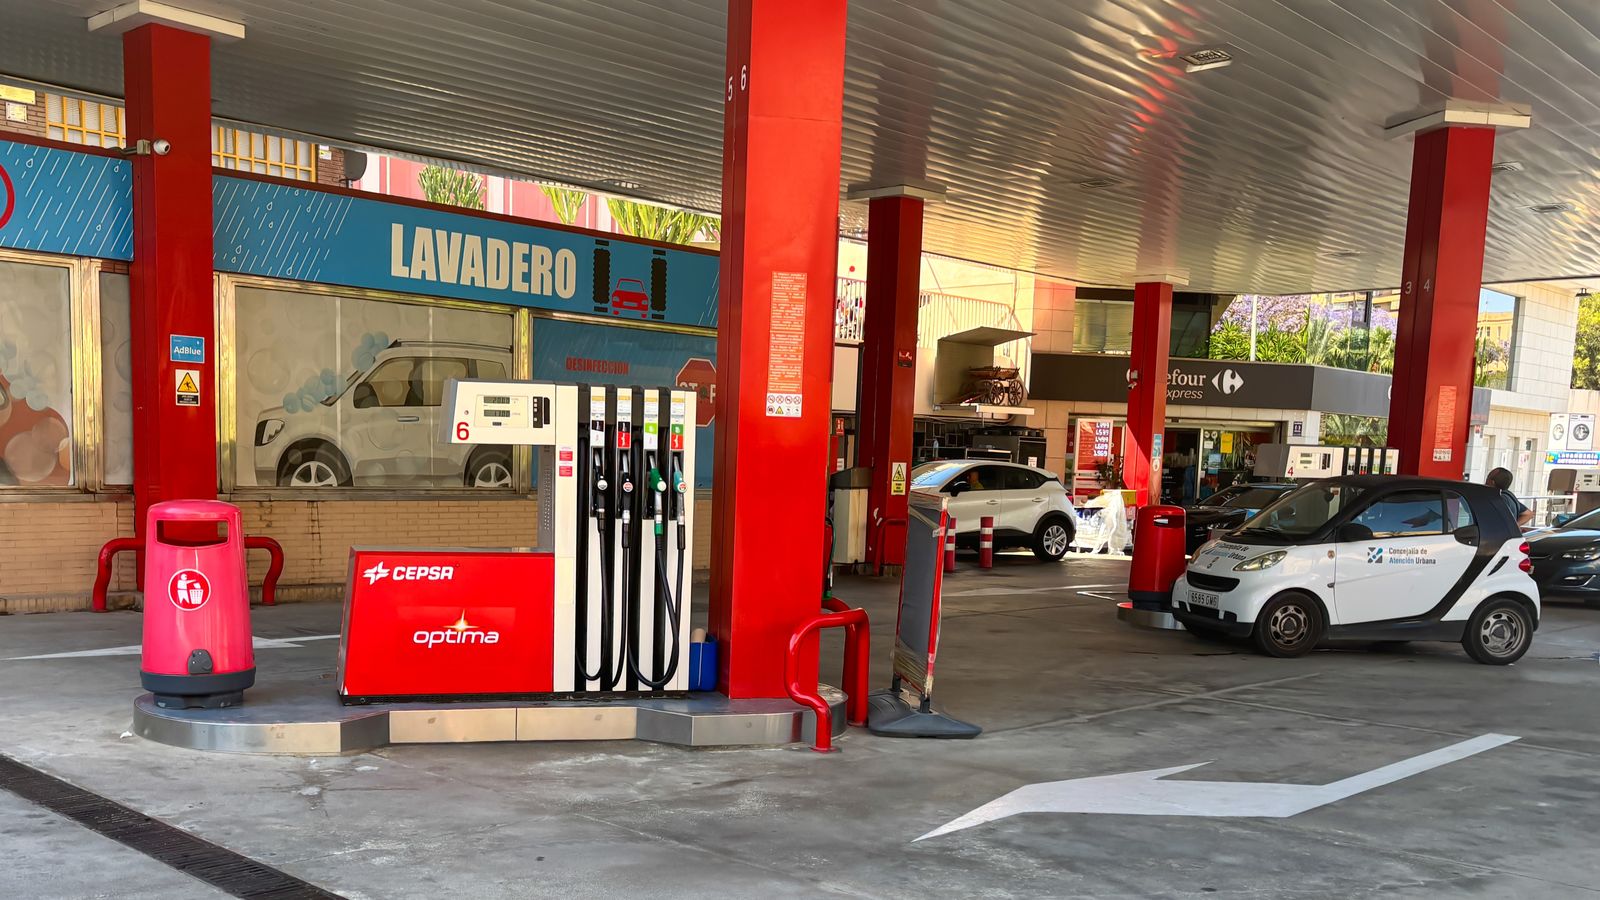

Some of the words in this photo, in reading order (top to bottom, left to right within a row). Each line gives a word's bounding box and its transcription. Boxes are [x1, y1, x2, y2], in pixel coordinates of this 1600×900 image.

[741, 65, 747, 90] 6
[728, 76, 733, 101] 5
[391, 223, 576, 299] LAVADERO
[1405, 281, 1412, 295] 3
[1423, 279, 1430, 292] 4
[174, 346, 202, 356] AdBlue
[1165, 388, 1204, 401] xpress
[456, 421, 470, 441] 6
[1287, 466, 1294, 476] 4
[1420, 547, 1427, 555] de
[1415, 557, 1436, 565] Urbana
[392, 566, 454, 580] CEPSA
[413, 629, 499, 648] optima
